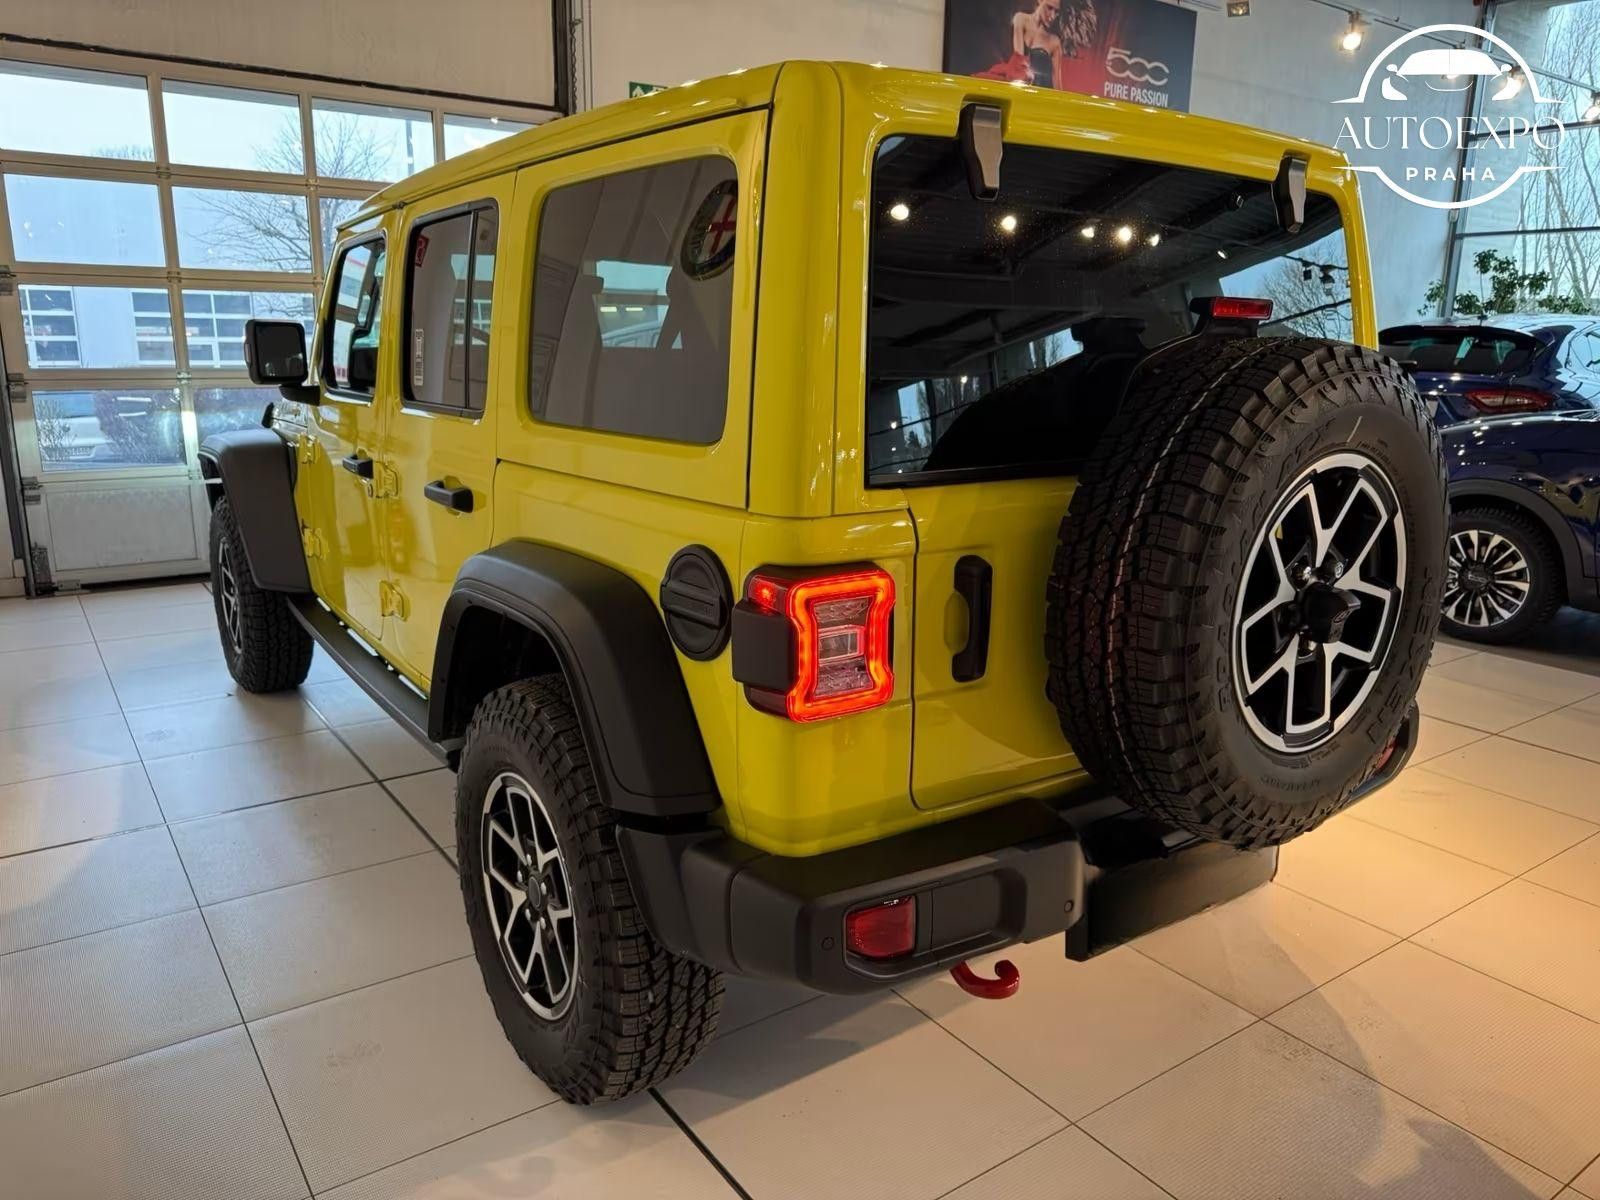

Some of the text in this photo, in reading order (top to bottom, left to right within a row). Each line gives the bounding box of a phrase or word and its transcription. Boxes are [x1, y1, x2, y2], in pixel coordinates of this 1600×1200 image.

[1105, 46, 1170, 86] 500
[1103, 81, 1169, 108] PURE PASSION
